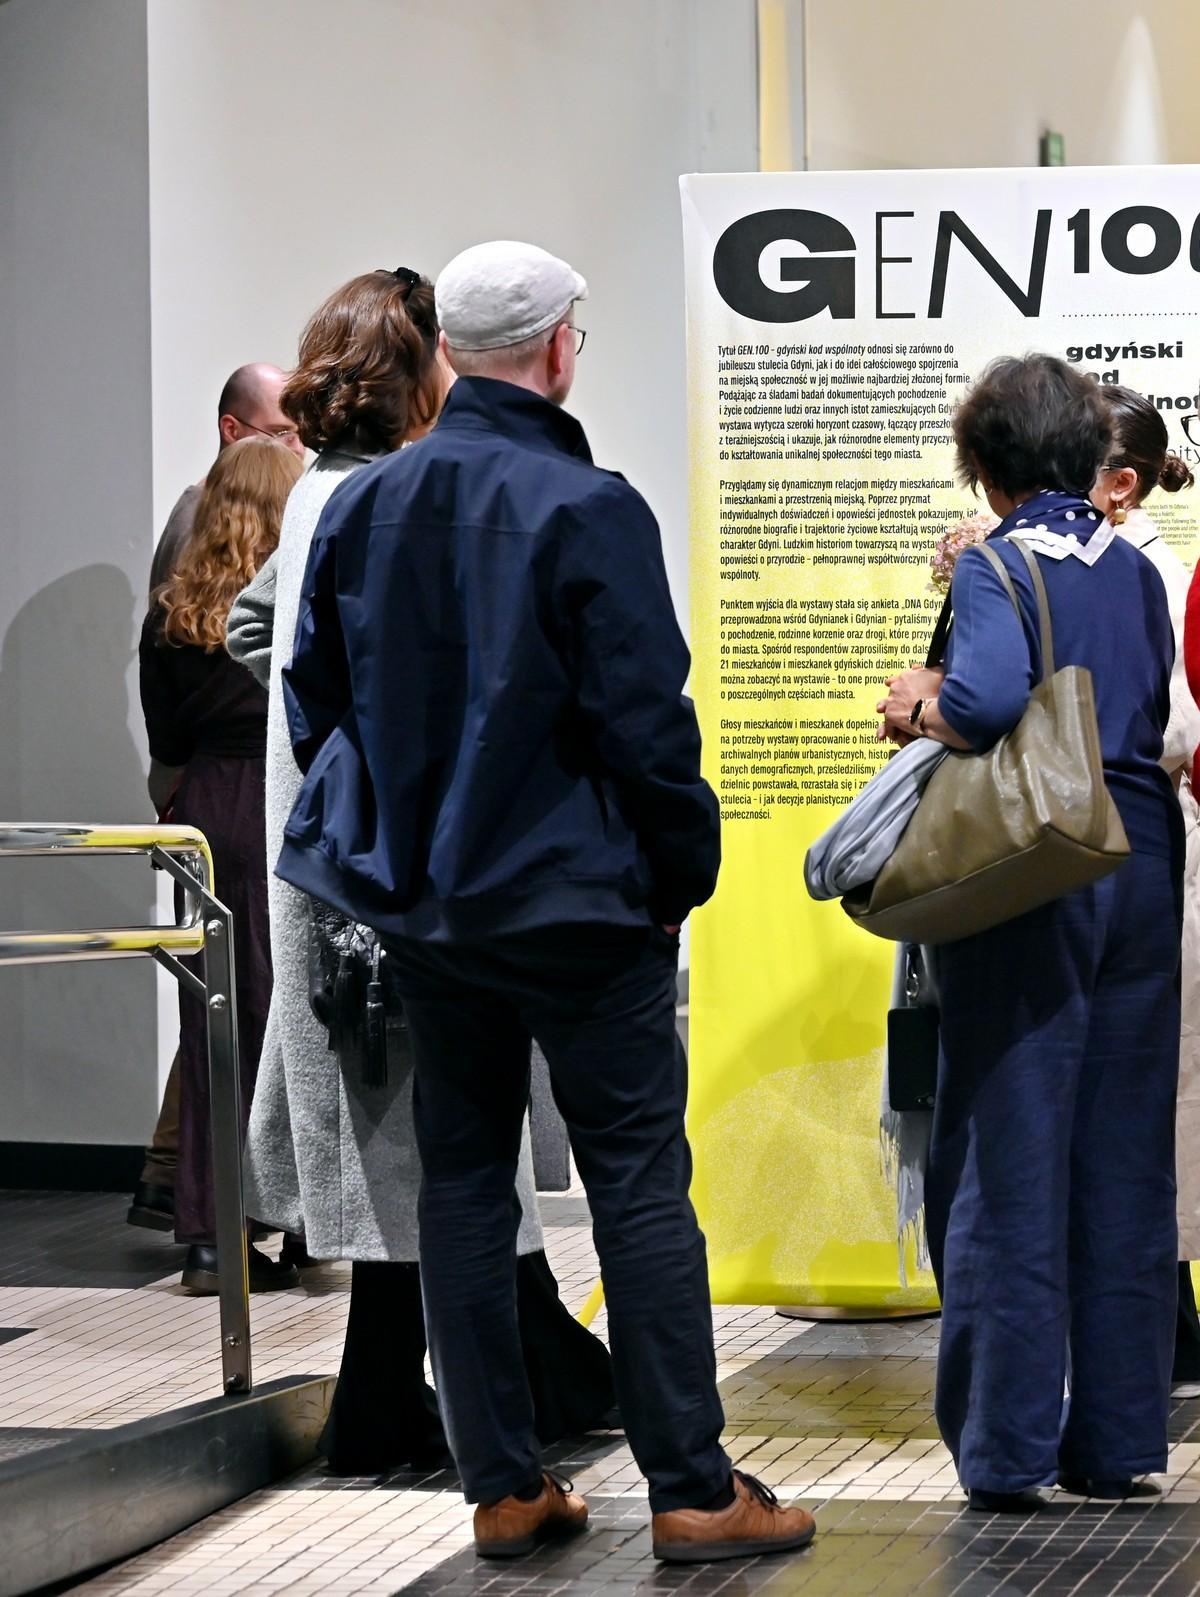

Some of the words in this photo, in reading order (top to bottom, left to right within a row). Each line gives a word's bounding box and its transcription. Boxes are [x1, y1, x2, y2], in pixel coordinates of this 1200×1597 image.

[718, 345, 736, 358] Tytuł
[776, 344, 808, 357] gdyński
[808, 344, 824, 355] kod
[824, 344, 866, 357] wspólnoty
[867, 343, 894, 354] odnosi
[895, 344, 908, 356] się
[908, 343, 943, 354] zarówno
[943, 343, 954, 354] do
[1066, 341, 1184, 362] gdyński
[718, 360, 756, 373] jubileuszu
[757, 359, 789, 370] stulecia
[815, 359, 829, 372] jak
[834, 359, 845, 370] do
[846, 358, 861, 369] idei
[863, 358, 917, 372] całościowego
[918, 358, 959, 371] spojrzenia
[719, 377, 729, 386] na
[730, 374, 759, 388] miejską
[760, 374, 808, 387] społeczność
[818, 374, 829, 387] jej
[830, 374, 865, 385] możliwie
[866, 373, 910, 386] najbardziej
[911, 373, 943, 386] złożonej
[718, 389, 757, 403] Podążając
[758, 392, 768, 400] za
[768, 389, 799, 400] śladami
[801, 389, 825, 400] badań
[826, 389, 896, 401] dokumentujących
[897, 388, 947, 401] pochodzenie
[723, 404, 742, 418] życie
[743, 404, 783, 415] codzienne
[784, 404, 803, 415] ludzi
[804, 406, 821, 415] oraz
[822, 403, 849, 417] innych
[851, 403, 869, 414] istot
[870, 403, 936, 416] zamieszkujących
[718, 420, 752, 433] wystawa
[753, 420, 785, 432] wytycza
[786, 419, 814, 430] szeroki
[816, 419, 850, 432] horyzont
[887, 418, 918, 431] łączący
[725, 434, 785, 447] teraźniejszością
[824, 434, 837, 447] jak
[838, 433, 882, 445] różnorodne
[883, 433, 920, 446] elementy
[719, 450, 730, 461] do
[731, 449, 784, 460] kształtowania
[785, 448, 821, 462] unikalnej
[822, 448, 872, 461] społeczności
[874, 449, 892, 461] tego
[720, 479, 766, 492] Przyglądamy
[768, 479, 779, 492] się
[781, 478, 833, 492] dynamicznym
[835, 478, 868, 491] relacjom
[871, 478, 897, 491] między
[900, 478, 954, 489] mieszkańcami
[724, 494, 776, 505] mieszkankami
[785, 493, 832, 506] przestrzenią
[868, 494, 898, 506] Poprzez
[900, 494, 931, 506] pryzmat
[719, 509, 778, 522] indywidualnych
[780, 508, 830, 519] doświadczeń
[836, 508, 876, 521] opowieści
[877, 508, 917, 521] jednostek
[720, 524, 762, 535] różnorodne
[763, 523, 798, 537] biografie
[804, 523, 845, 536] trajektorie
[847, 523, 878, 536] życiowe
[879, 523, 919, 536] kształtują
[720, 540, 757, 550] charakter
[783, 538, 814, 549] Ludzkim
[816, 538, 853, 549] historiom
[855, 539, 898, 551] towarzyszą
[900, 540, 910, 549] na
[720, 554, 758, 567] opowieści
[767, 553, 805, 567] przyrodzie
[813, 554, 865, 566] pełnoprawnej
[868, 553, 928, 566] współtwórczyni
[720, 599, 754, 610] Punktem
[755, 598, 784, 612] wyjścia
[785, 598, 798, 609] dla
[799, 599, 834, 611] wystawy
[835, 599, 855, 609] stała
[857, 598, 869, 611] się
[870, 598, 900, 609] ankieta
[720, 614, 782, 626] przeprowadzona
[783, 613, 807, 624] wśród
[808, 613, 849, 626] Gdynianek
[855, 614, 887, 626] Gdynian
[894, 614, 932, 626] pytaliśmy
[778, 629, 811, 639] rodzinne
[812, 628, 845, 639] korzenie
[846, 630, 864, 639] oraz
[889, 628, 910, 639] które
[720, 644, 731, 655] do
[761, 643, 792, 656] Spośród
[793, 643, 849, 656] respondentów
[850, 643, 899, 656] zaprosiliśmy
[900, 644, 911, 654] do
[720, 659, 729, 669] 21
[731, 658, 782, 670] mieszkańców
[788, 658, 832, 669] mieszkanek
[834, 658, 873, 671] gdyńskich
[720, 674, 745, 684] można
[747, 673, 781, 687] zobaczyć
[782, 676, 792, 684] na
[793, 673, 830, 686] wystawie
[838, 674, 846, 684] to
[848, 675, 862, 684] one
[727, 688, 786, 702] poszczególnych
[787, 688, 825, 701] częściach
[720, 719, 742, 732] Głosy
[744, 718, 793, 730] mieszkańców
[799, 718, 844, 729] mieszkanek
[846, 719, 879, 732] dopełnia
[720, 736, 731, 744] na
[732, 734, 766, 747] potrzeby
[766, 734, 800, 747] wystawy
[800, 734, 851, 746] opracowanie
[720, 748, 772, 762] archiwalnych
[773, 748, 800, 761] planów
[720, 764, 749, 776] danych
[720, 779, 751, 789] dzielnic
[801, 779, 839, 790] rozrastała
[840, 779, 853, 791] się
[720, 794, 751, 805] stulecia
[763, 794, 775, 807] jak
[777, 793, 804, 807] decyzje
